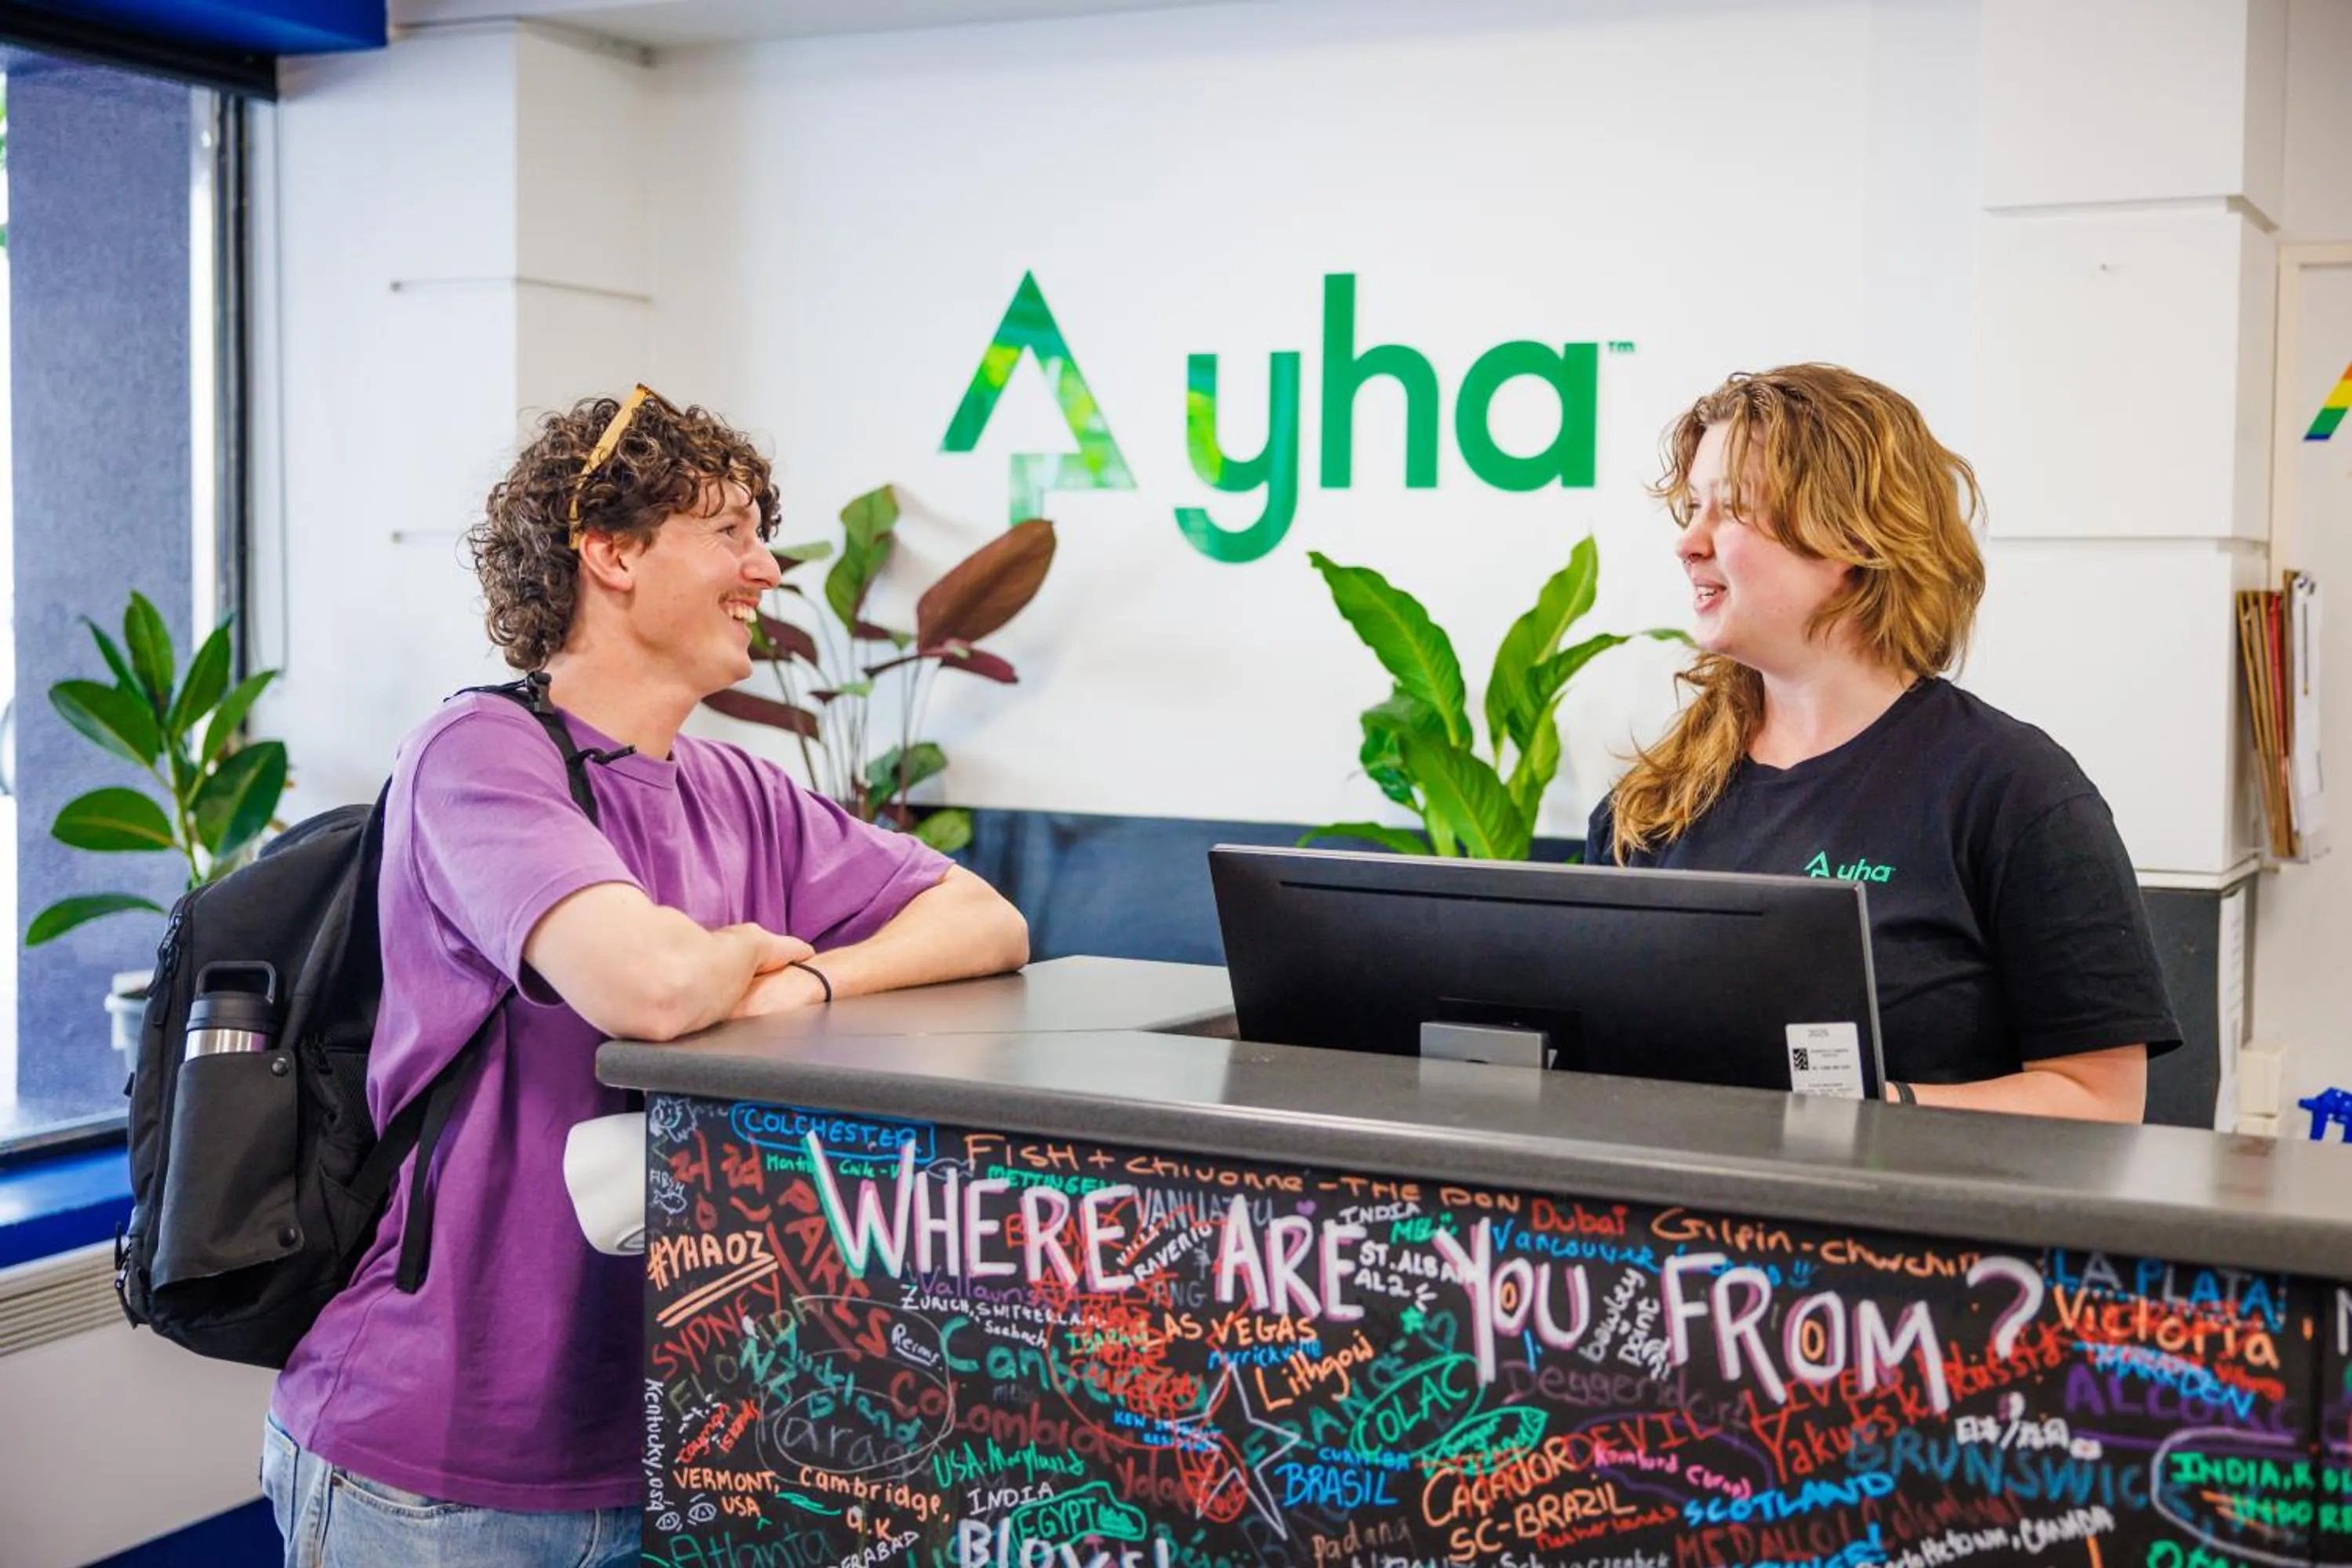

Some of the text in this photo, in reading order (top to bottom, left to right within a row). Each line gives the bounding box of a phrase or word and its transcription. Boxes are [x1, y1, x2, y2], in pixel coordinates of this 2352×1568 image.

[1174, 273, 1598, 564] yha
[964, 1134, 1080, 1172] FISH
[1439, 1186, 1520, 1213] DON
[1339, 1202, 1421, 1225] INDIA
[1532, 1198, 1630, 1236] Dubai
[801, 1127, 1137, 1294] WHERE
[1215, 1193, 1367, 1323] ARE
[1433, 1216, 1589, 1384] YOU
[1210, 1312, 1319, 1346] VEGAS
[1254, 1330, 1374, 1411] Lithgow
[720, 1495, 761, 1519] USA
[967, 1480, 1055, 1516] INDIA
[1273, 1461, 1399, 1508] BRASIL
[1682, 1471, 1894, 1528] SCOTLAND
[1017, 1496, 1098, 1542] EGYPT
